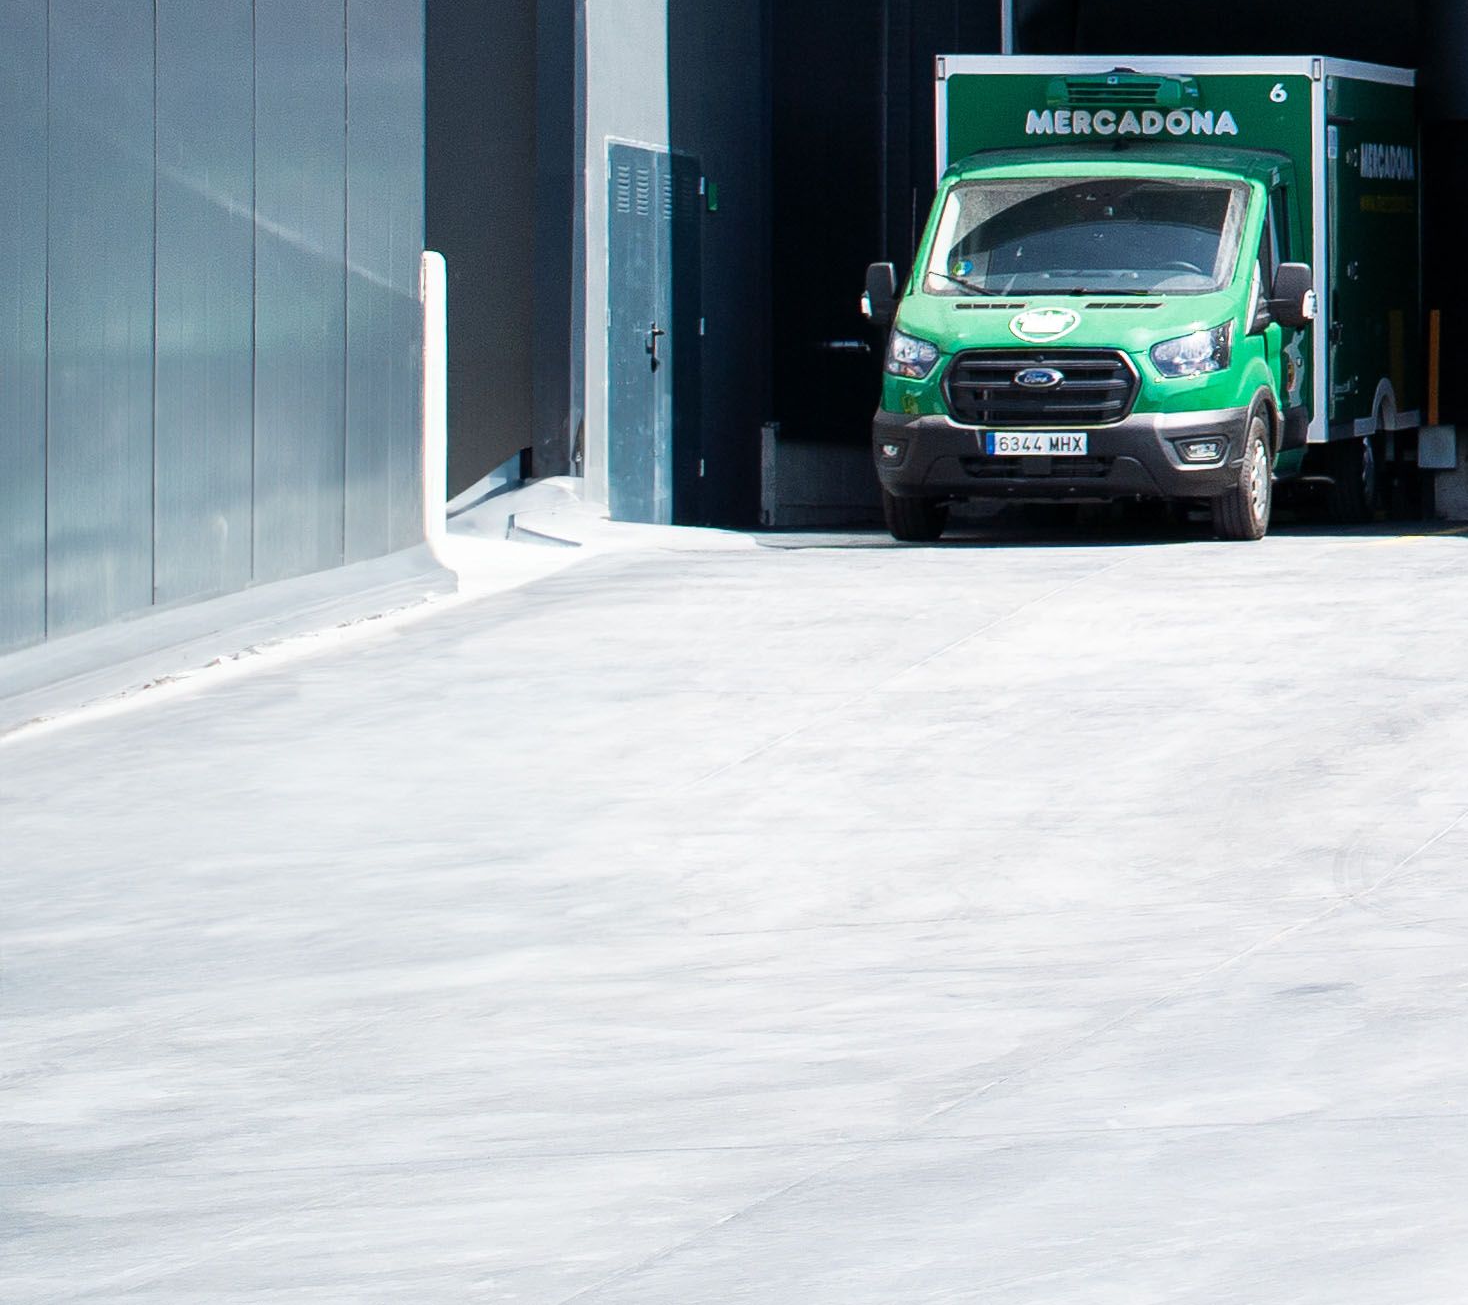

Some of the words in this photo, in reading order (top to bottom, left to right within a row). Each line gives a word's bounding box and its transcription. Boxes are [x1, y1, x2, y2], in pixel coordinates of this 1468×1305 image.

[1269, 83, 1287, 103] 6
[1025, 110, 1238, 136] MERCADONA
[999, 436, 1042, 452] 6344
[1049, 436, 1082, 452] MHX
